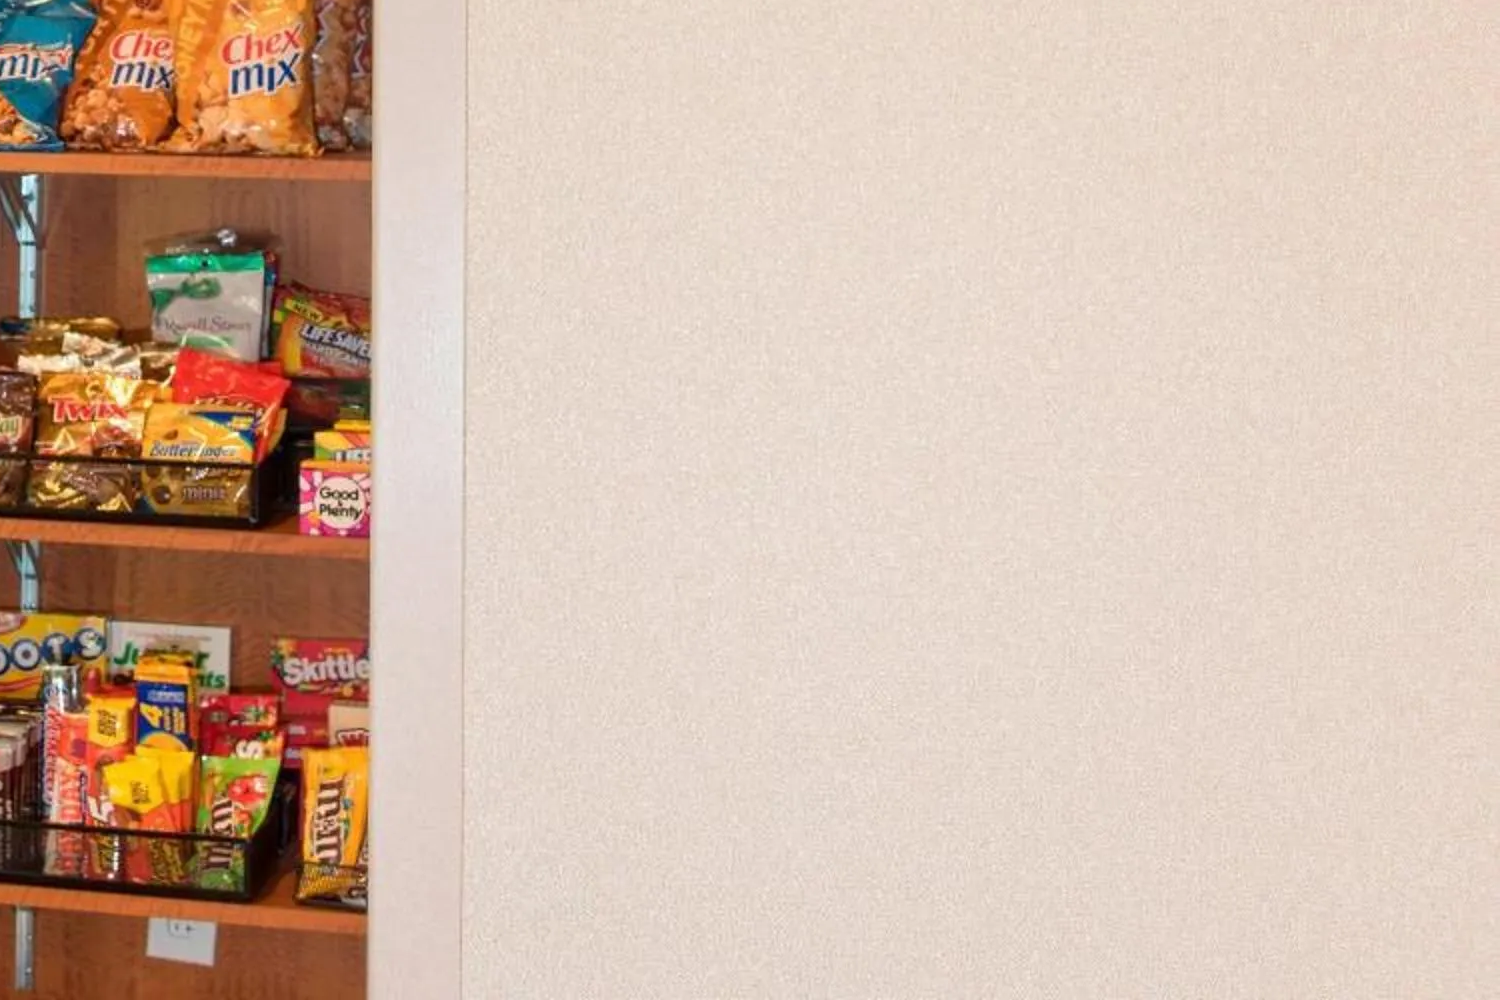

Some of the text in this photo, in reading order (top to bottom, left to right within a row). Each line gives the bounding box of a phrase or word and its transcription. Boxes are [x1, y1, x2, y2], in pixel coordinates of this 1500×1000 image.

[110, 31, 174, 62] Che
[221, 23, 303, 66] Chex
[111, 61, 175, 90] mix
[230, 53, 301, 96] mix
[320, 485, 359, 501] Good
[319, 502, 362, 521] Plenty
[283, 654, 370, 686] Skittle
